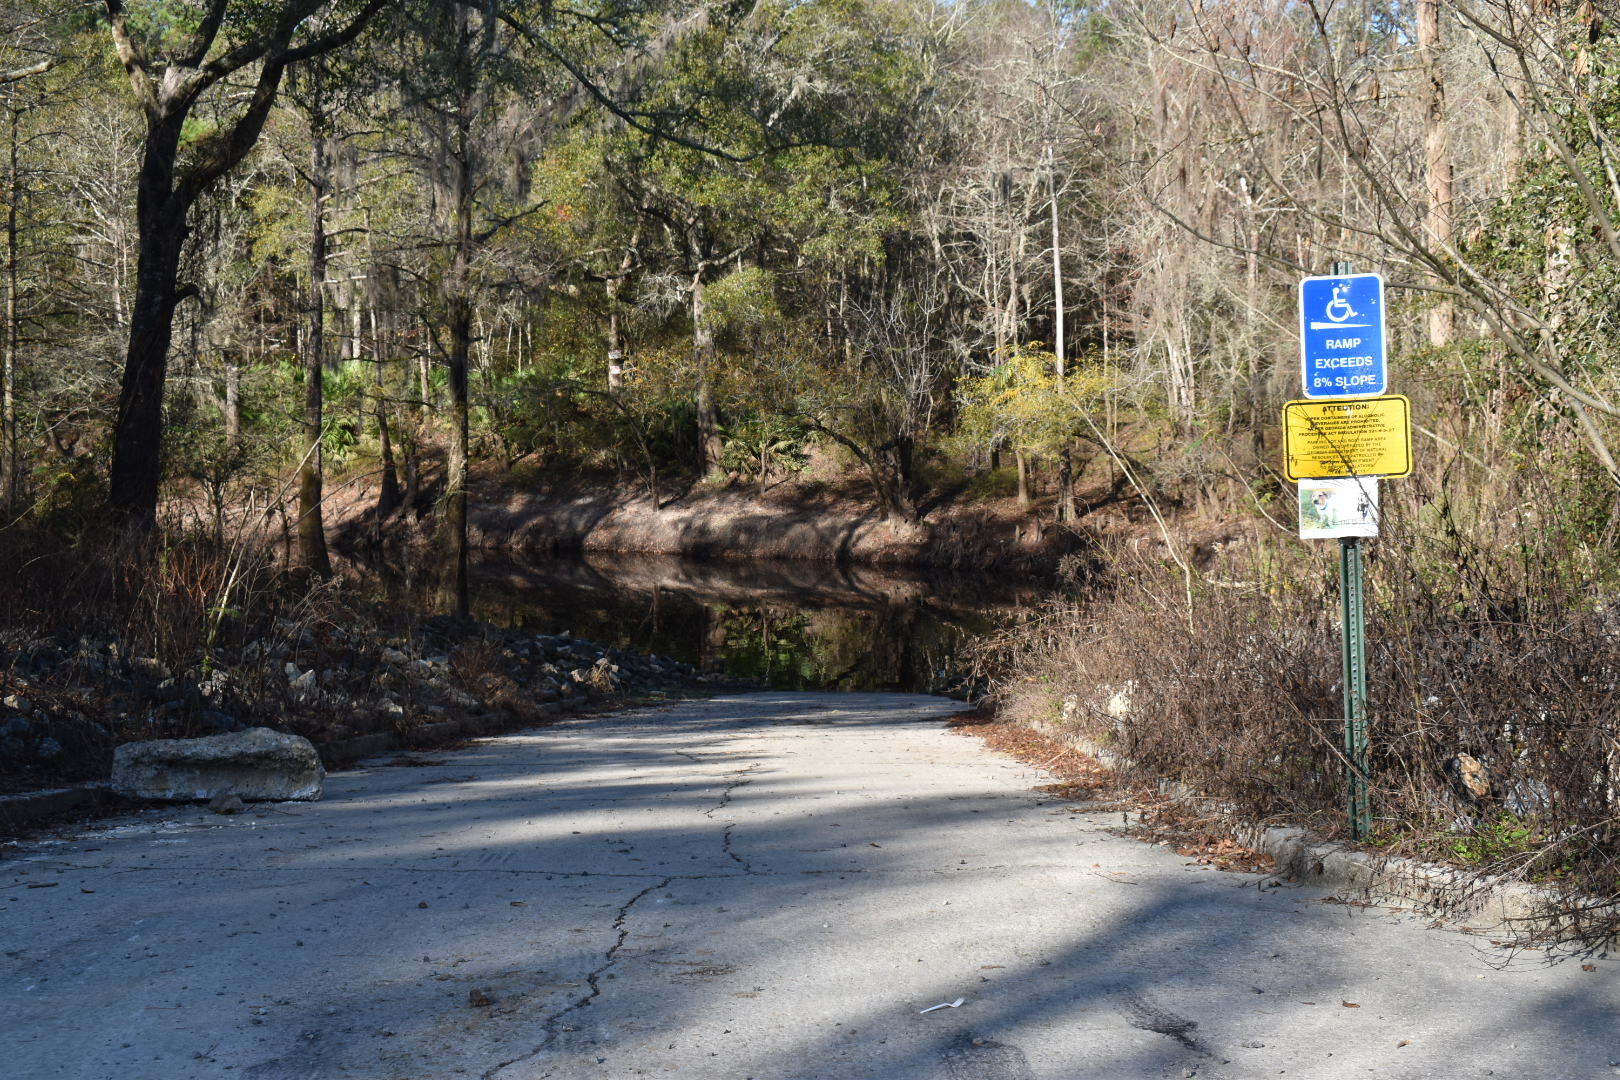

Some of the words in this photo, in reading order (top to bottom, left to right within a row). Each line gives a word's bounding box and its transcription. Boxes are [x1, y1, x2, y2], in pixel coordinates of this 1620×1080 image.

[1325, 338, 1361, 350] RAMP
[1315, 356, 1373, 368] EXCEEDS
[1313, 377, 1333, 388] 8%
[1335, 374, 1377, 387] SLOPE
